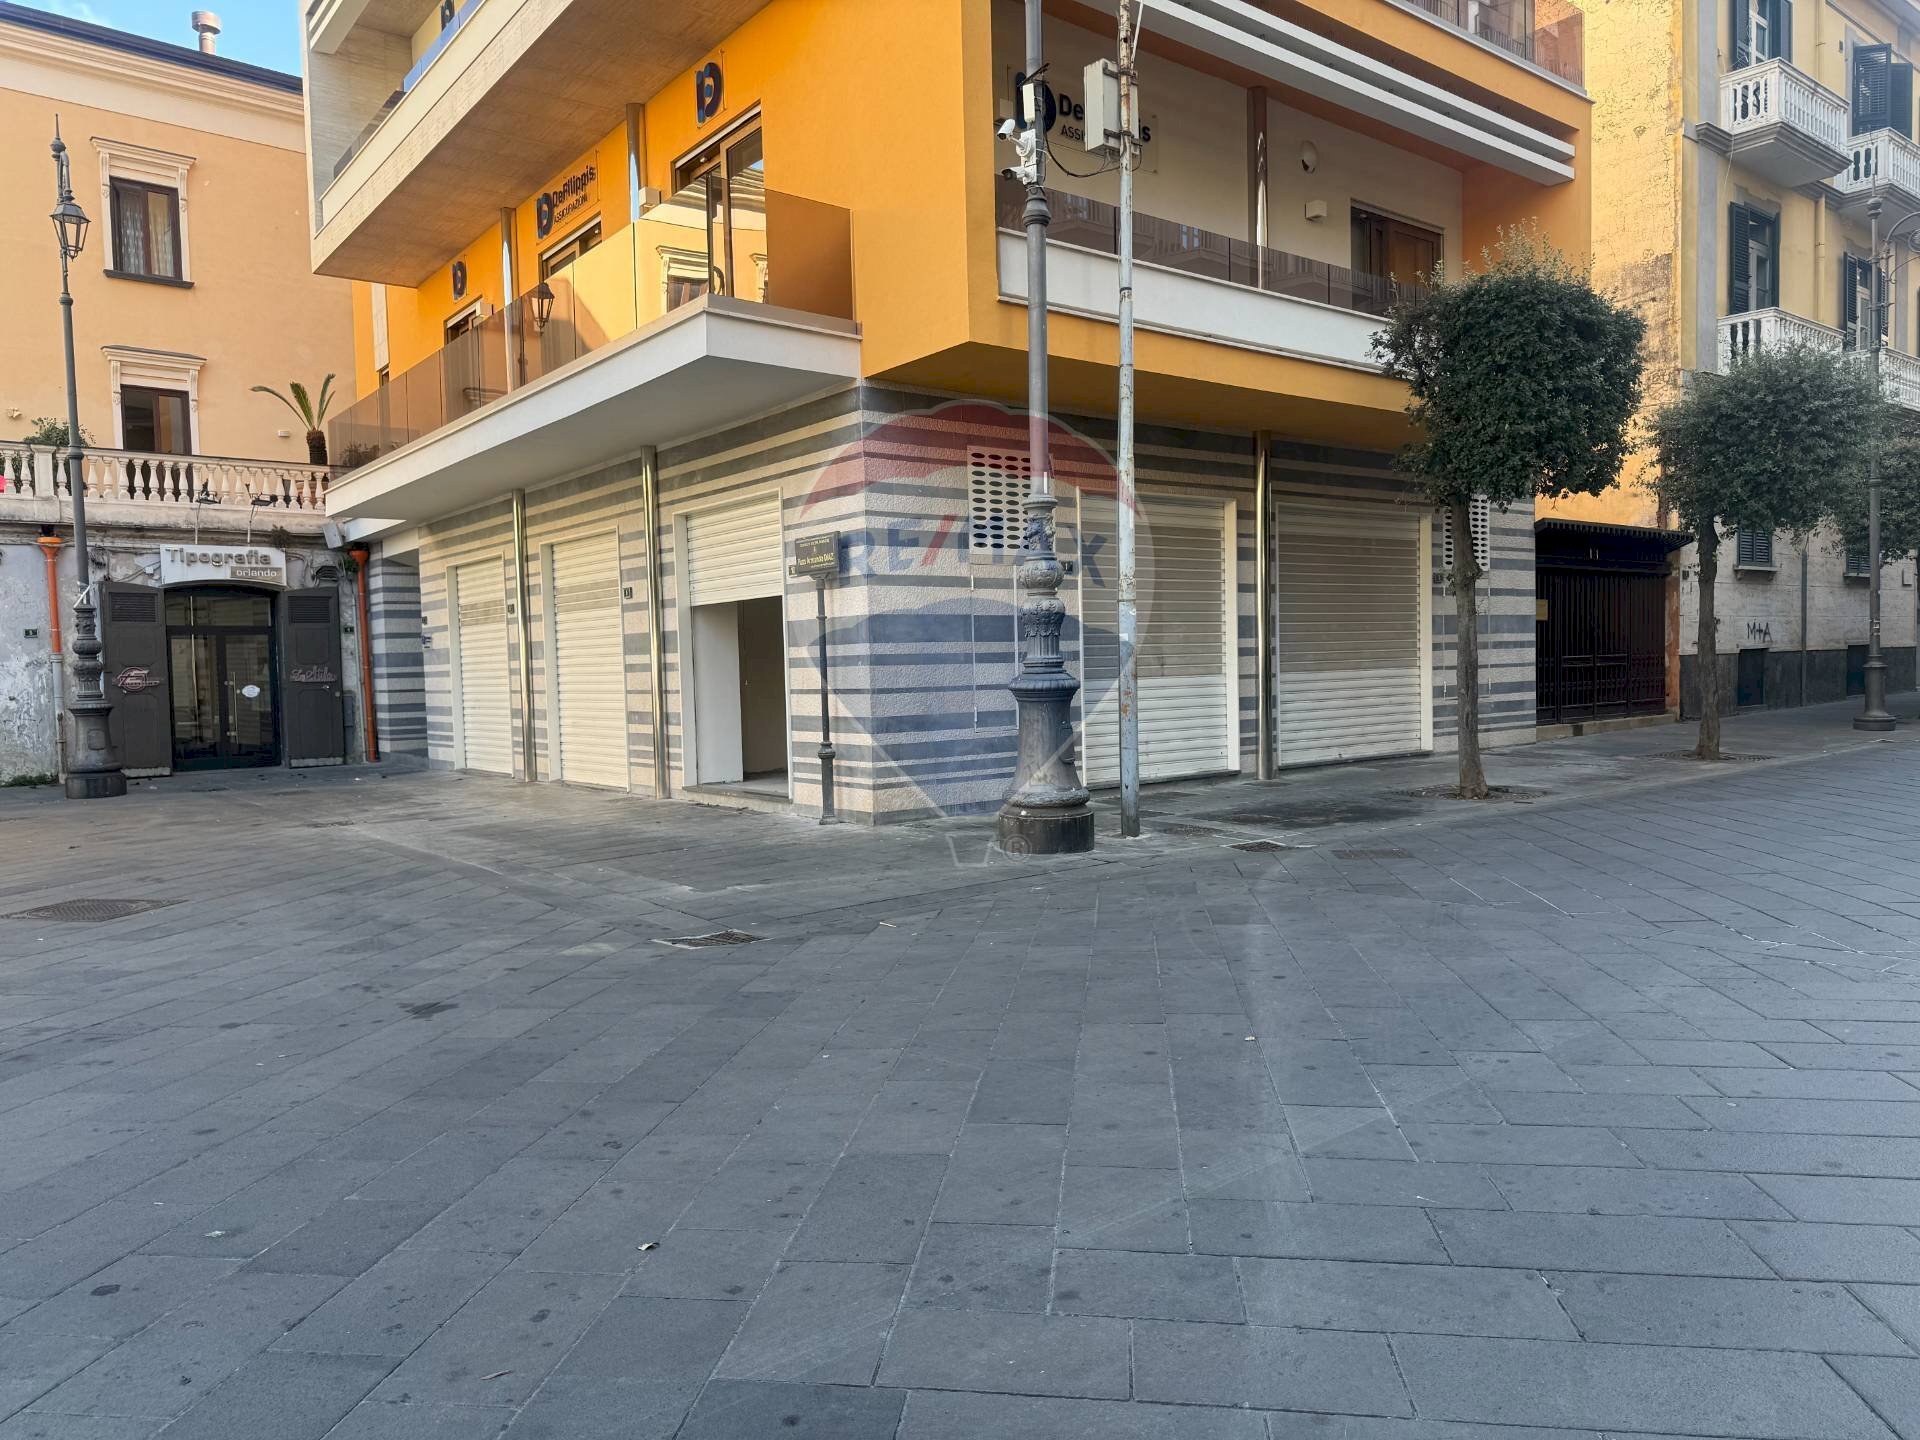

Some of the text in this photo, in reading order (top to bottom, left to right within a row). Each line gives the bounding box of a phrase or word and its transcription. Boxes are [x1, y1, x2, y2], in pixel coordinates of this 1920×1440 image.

[165, 547, 272, 567] Tipografia
[236, 568, 277, 577] orlando
[1747, 621, 1773, 643] M+A
